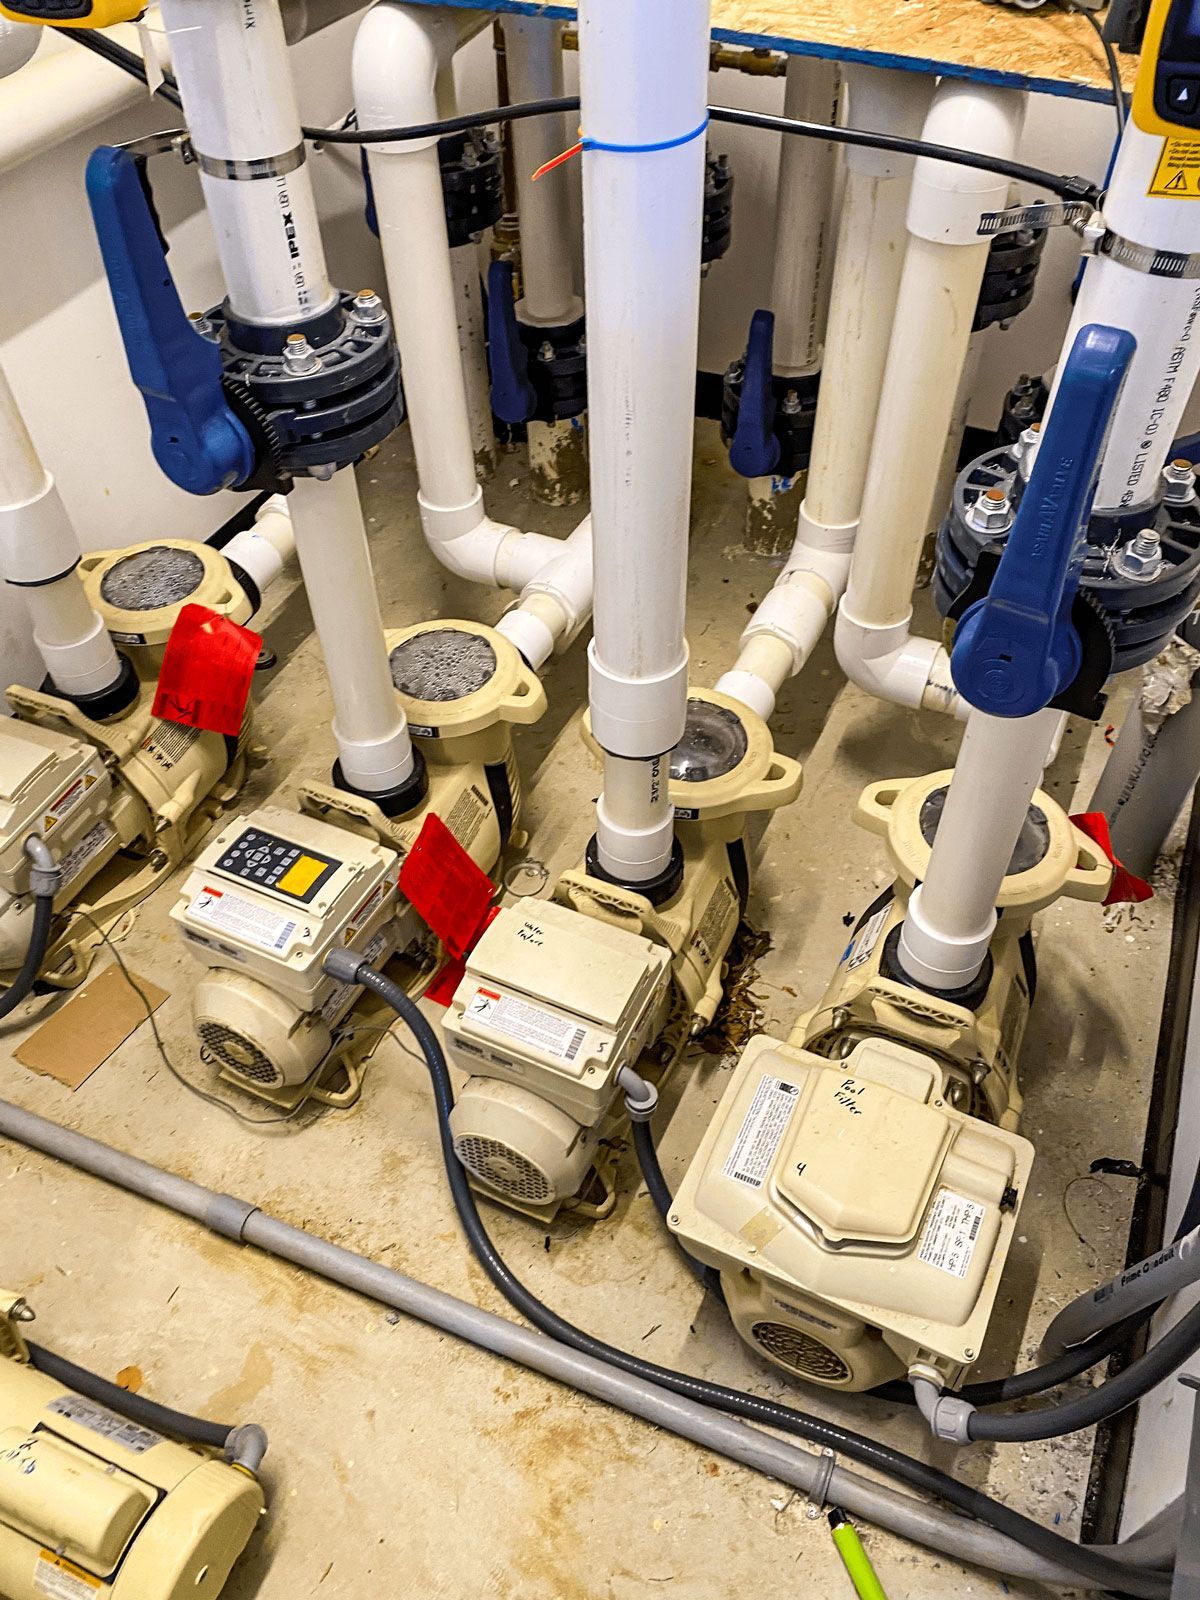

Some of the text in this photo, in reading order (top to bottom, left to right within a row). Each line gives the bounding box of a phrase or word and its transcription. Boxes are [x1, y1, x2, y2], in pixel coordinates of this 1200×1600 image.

[283, 212, 299, 259] IPEX
[1167, 346, 1186, 374] ASTM
[1127, 452, 1148, 487] LISTED
[303, 927, 311, 938] 3
[840, 1079, 866, 1095] Pool
[833, 1091, 862, 1115] Filter
[796, 1162, 807, 1177] 4
